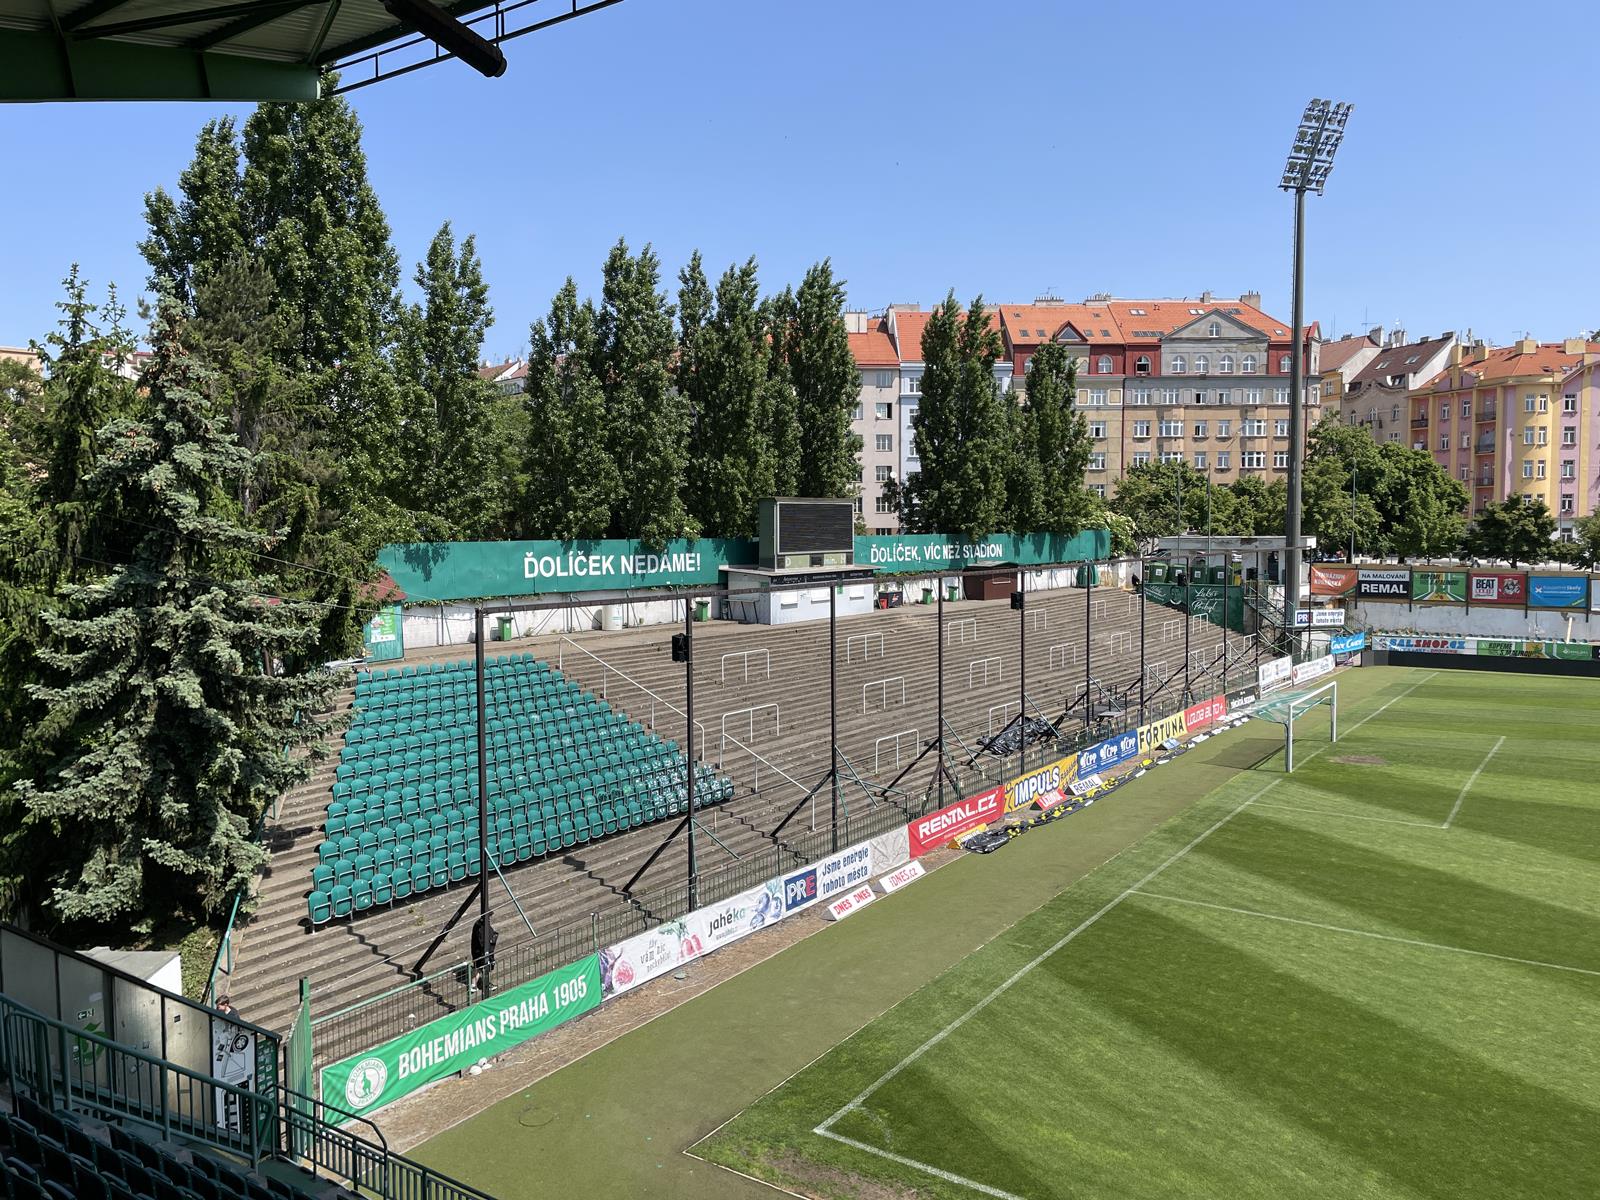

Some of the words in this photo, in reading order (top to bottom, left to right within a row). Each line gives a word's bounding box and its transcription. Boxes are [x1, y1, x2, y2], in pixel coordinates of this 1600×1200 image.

[524, 551, 615, 579] ĎOLÍČEK
[621, 550, 701, 575] NEDÁME!
[923, 542, 941, 560] VÍC
[943, 541, 960, 559] NEŽ
[963, 544, 1003, 559] STADION
[1361, 583, 1408, 594] REMAL
[1475, 579, 1496, 589] BEAT
[1139, 716, 1185, 750] FORTUNA
[1014, 766, 1061, 807] IMPULS
[1073, 778, 1098, 794] REMAL
[918, 793, 998, 840] RENTAL.CZ
[822, 860, 841, 877] Jsme
[842, 846, 869, 868] energie
[786, 875, 815, 905] PRE
[823, 876, 846, 895] tohoto
[847, 865, 868, 883] města
[889, 867, 918, 888] iDNES.cz
[833, 898, 853, 915] DNES
[853, 888, 872, 904] DNES
[399, 1015, 497, 1080] BOHEMIANS
[500, 992, 550, 1035] PRAHA
[552, 974, 588, 1010] 1905
